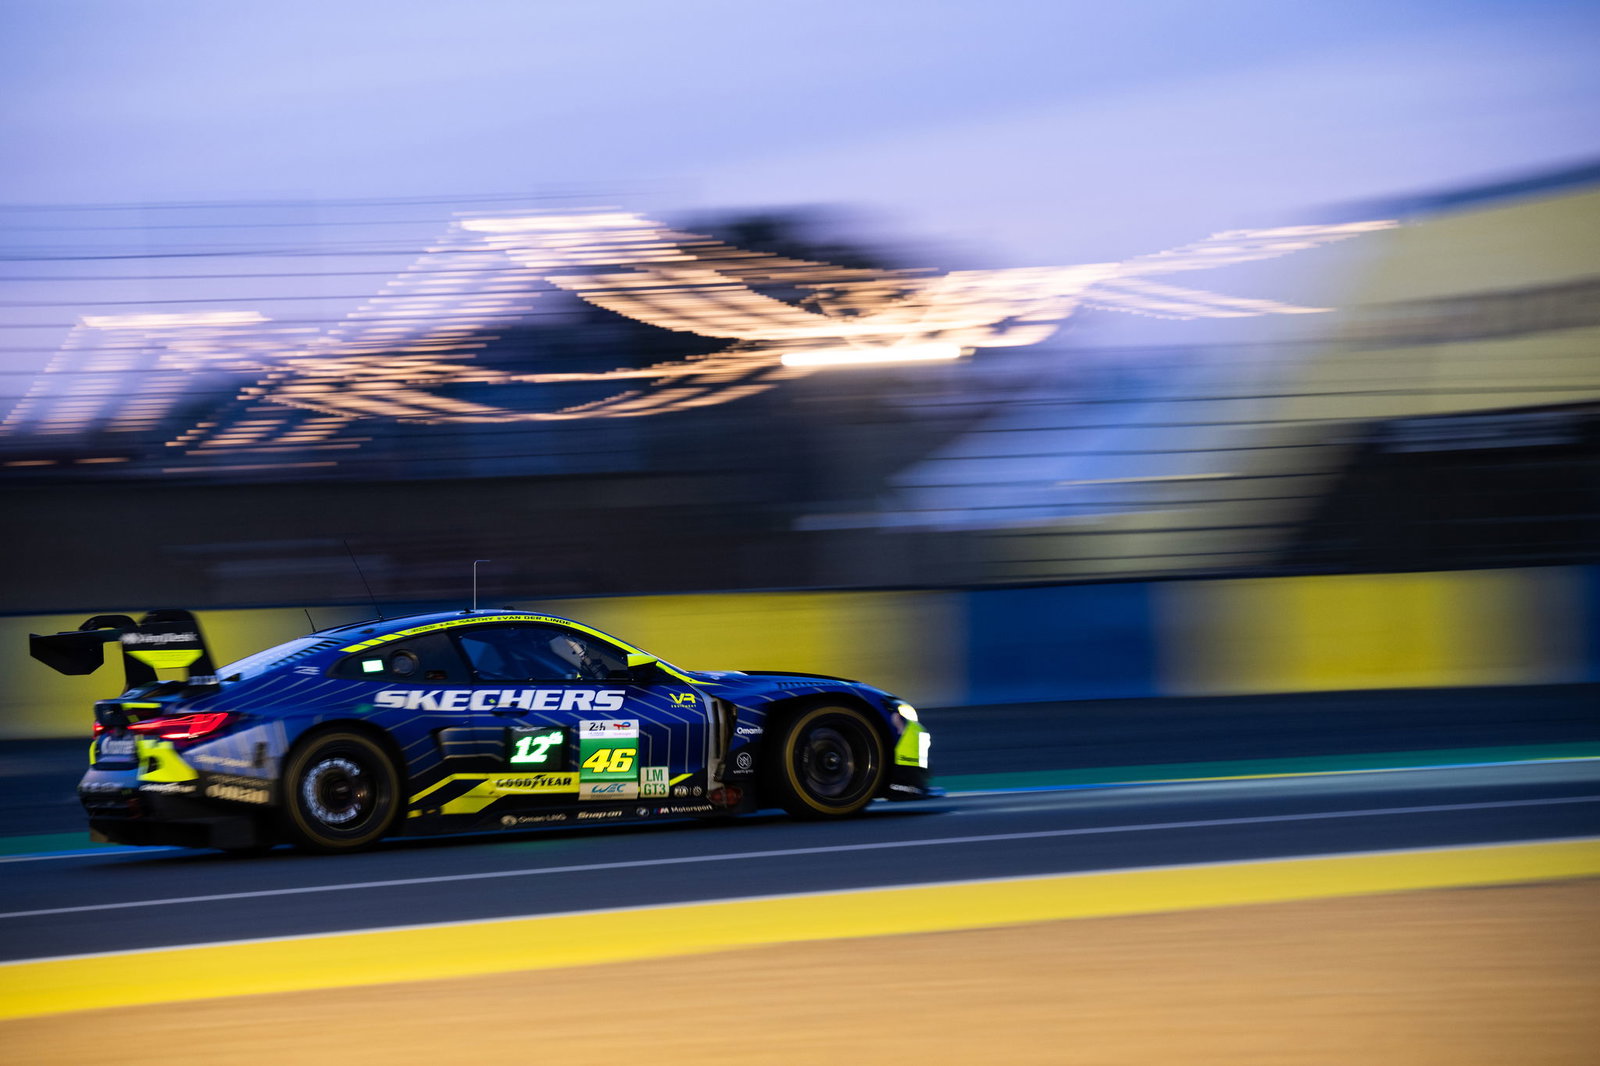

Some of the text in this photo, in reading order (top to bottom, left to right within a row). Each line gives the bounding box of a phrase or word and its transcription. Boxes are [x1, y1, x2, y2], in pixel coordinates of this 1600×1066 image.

[544, 617, 572, 625] LINDE
[374, 689, 625, 712] SKECHERS
[669, 693, 697, 704] VR
[582, 748, 637, 773] 46
[496, 774, 572, 789] GOODYEAR
[646, 769, 664, 782] LM
[591, 783, 626, 793] WEC
[644, 783, 667, 796] GT3
[671, 804, 713, 813] Motorsport
